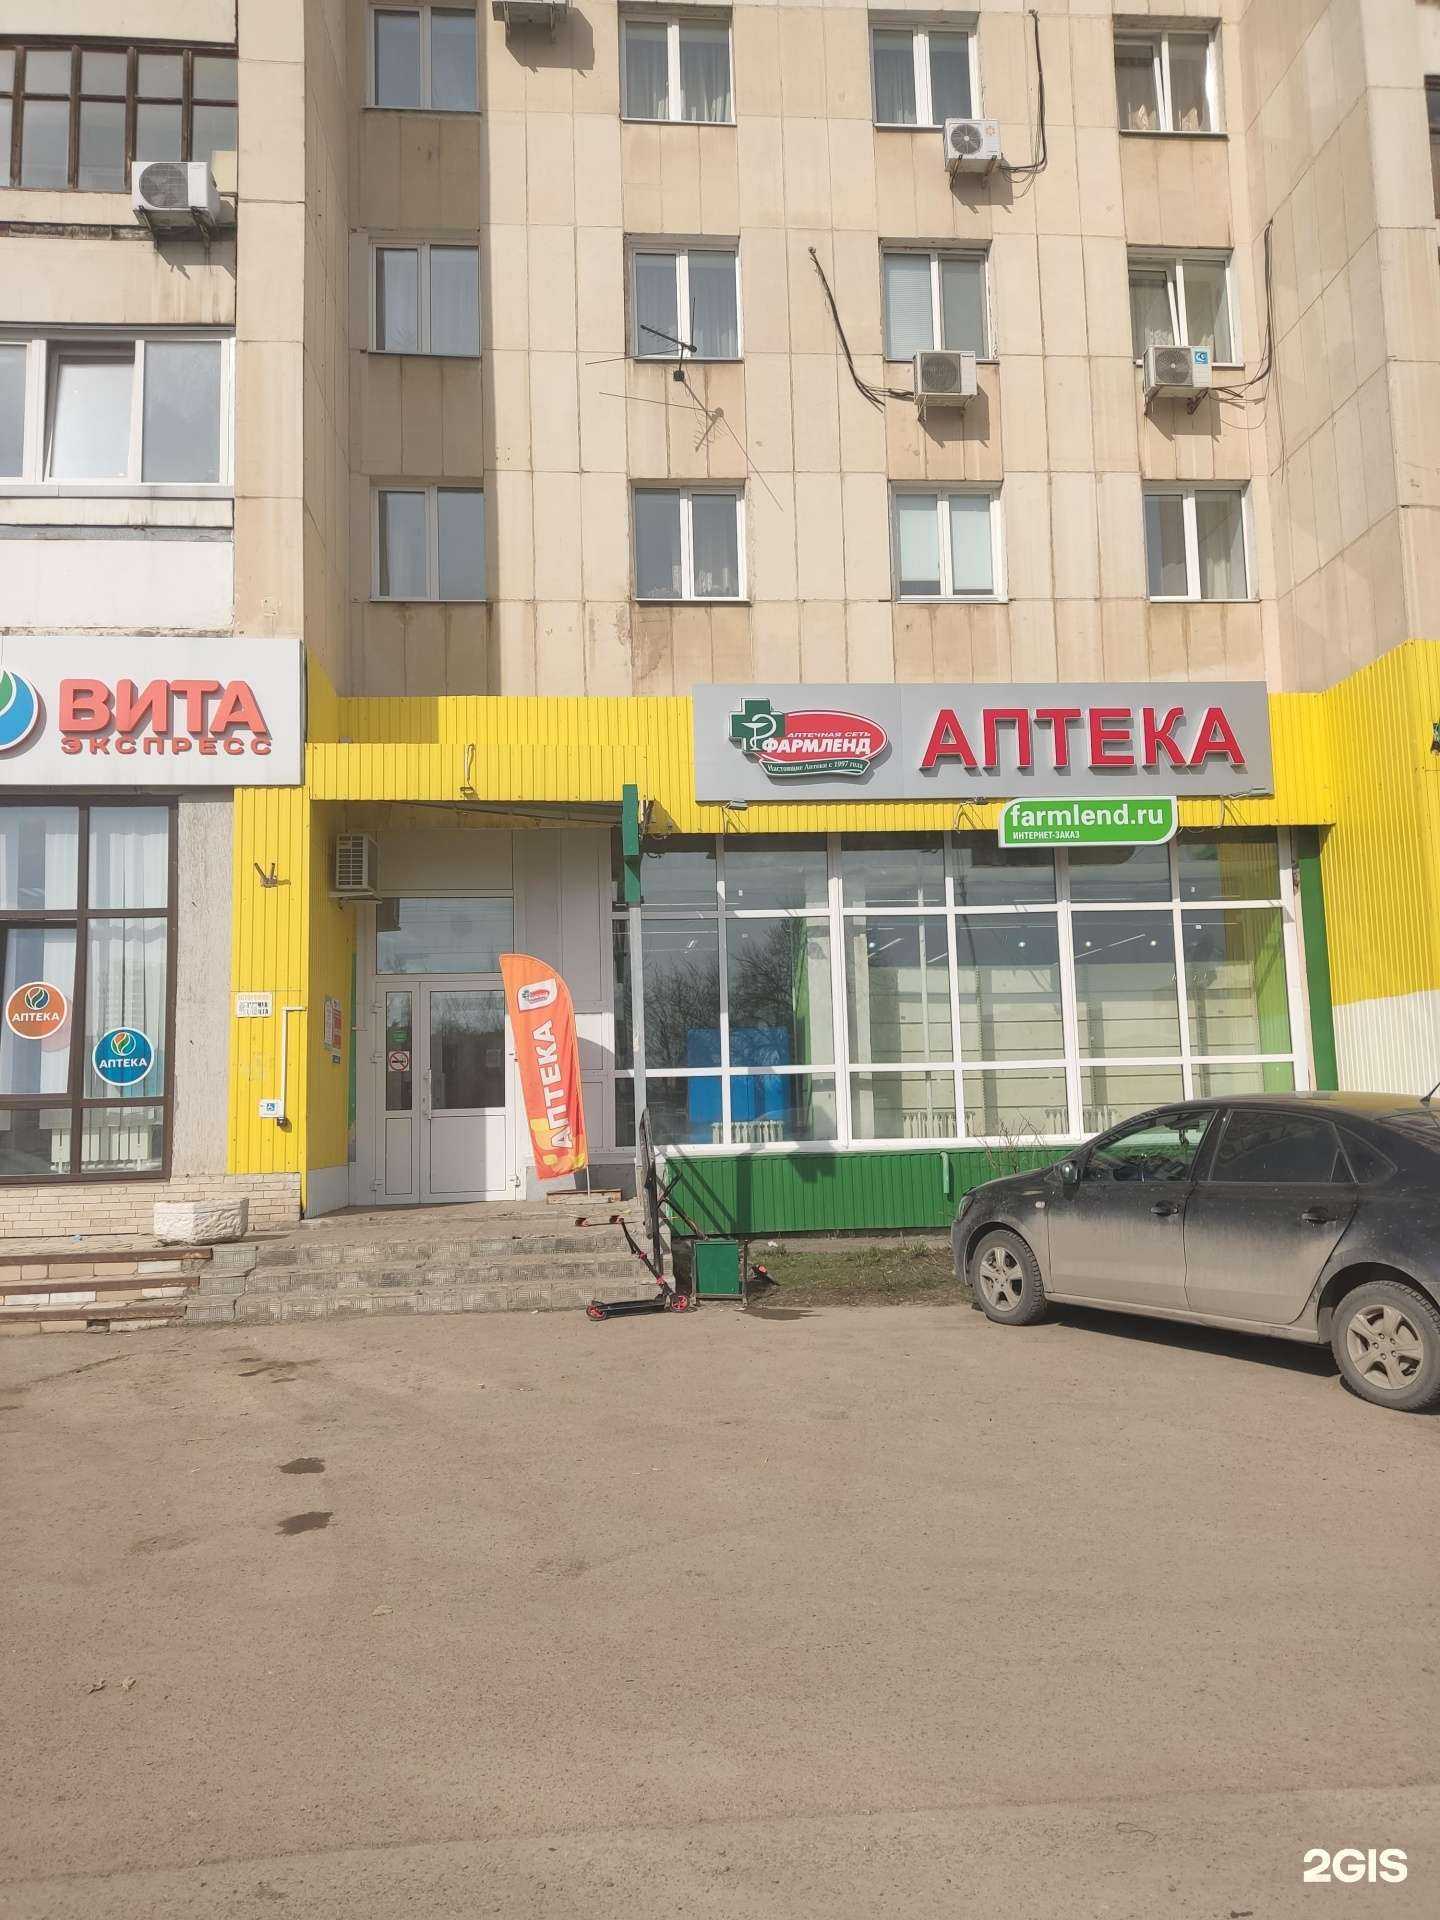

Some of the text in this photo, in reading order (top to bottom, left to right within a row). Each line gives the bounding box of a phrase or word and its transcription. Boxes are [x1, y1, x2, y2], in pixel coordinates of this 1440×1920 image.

[59, 678, 271, 737] ВИТА
[61, 736, 272, 755] ЭКСПРЕСС
[762, 737, 871, 754] ФАРМЛЕНД
[920, 706, 1247, 769] АПТЕКА
[834, 760, 849, 768] 1997
[1010, 803, 1163, 827] farmlend.ru
[1012, 830, 1080, 840] ИНТЕРНЕТ-ЗАКАЗ
[11, 1011, 61, 1023] АПТЕКА
[99, 1057, 148, 1069] АПТЕКА
[532, 1018, 574, 1149] АПТЕКА
